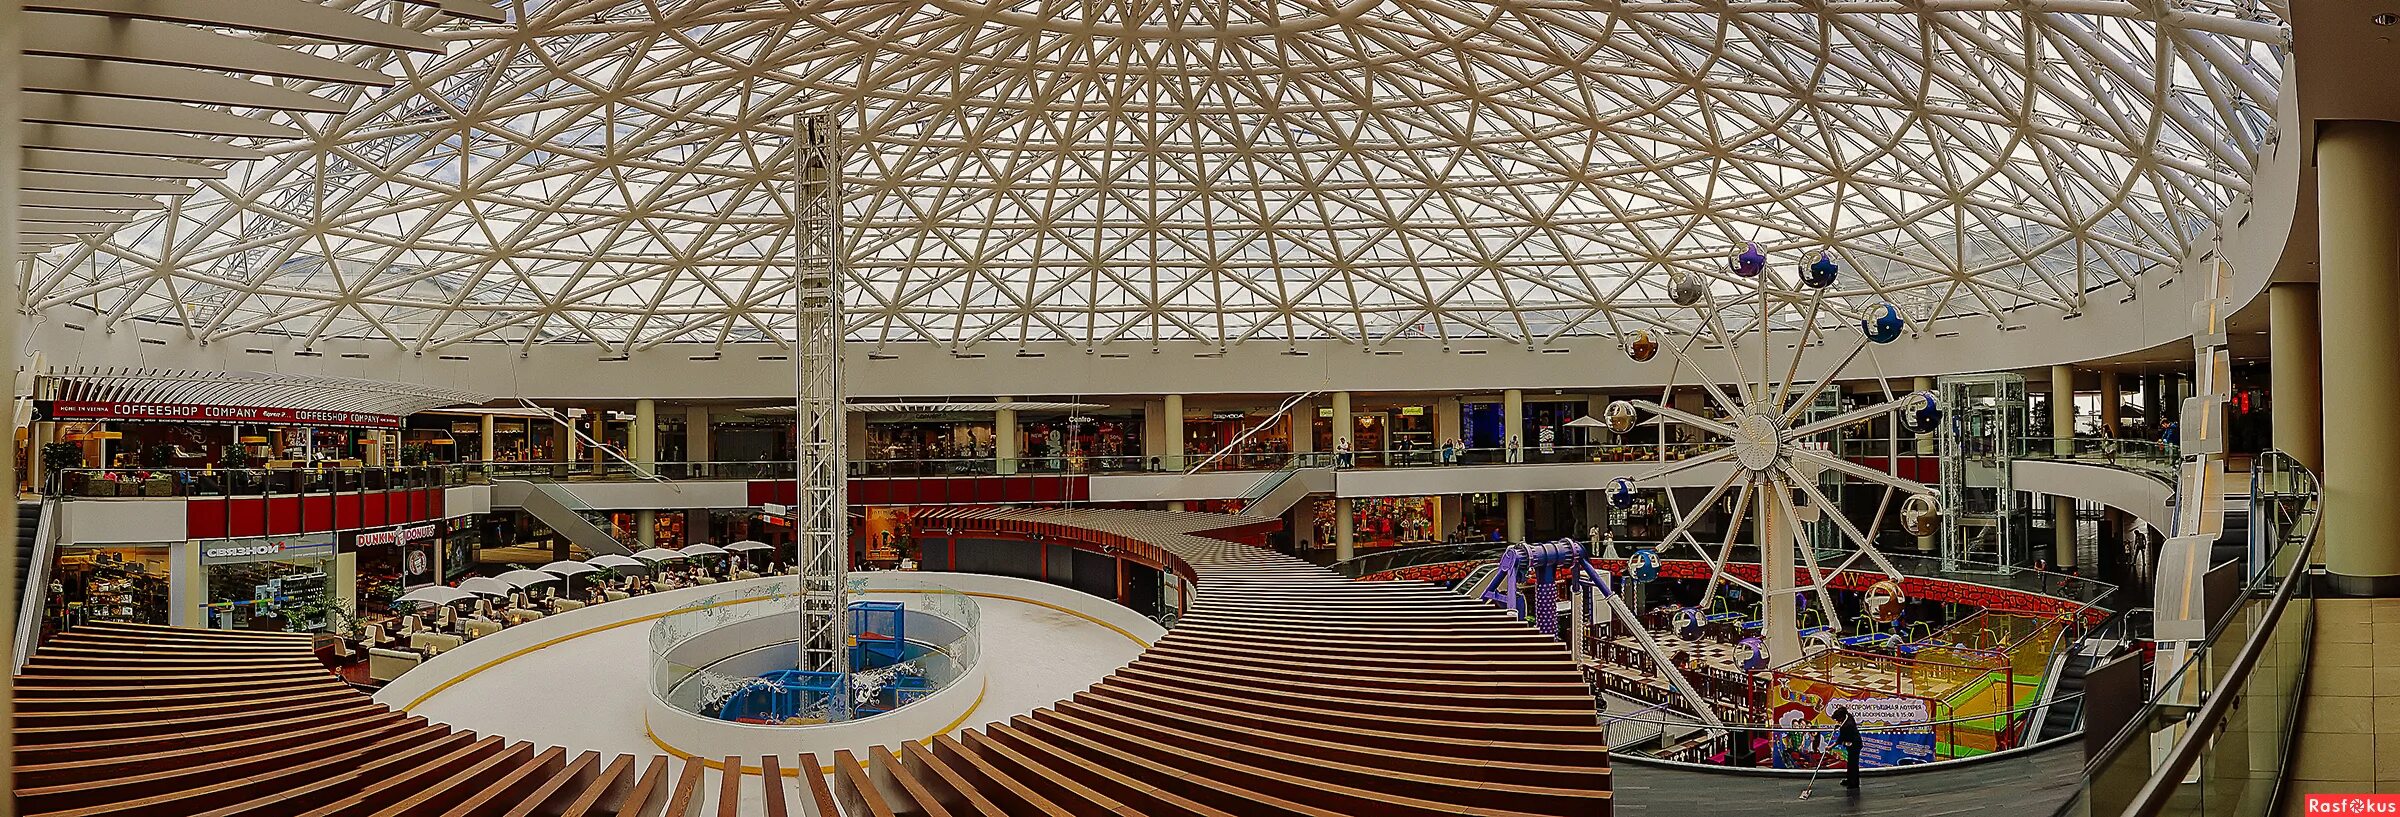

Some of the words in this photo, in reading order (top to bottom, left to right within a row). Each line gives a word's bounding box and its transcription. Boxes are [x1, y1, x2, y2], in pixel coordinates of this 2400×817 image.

[114, 404, 198, 416] COFFEESHOP
[205, 406, 258, 418] COMPANY
[295, 410, 348, 422] COFFEESHOP
[350, 413, 380, 423] COMPANY
[404, 524, 436, 541] DONUTS
[1841, 571, 1860, 587] W
